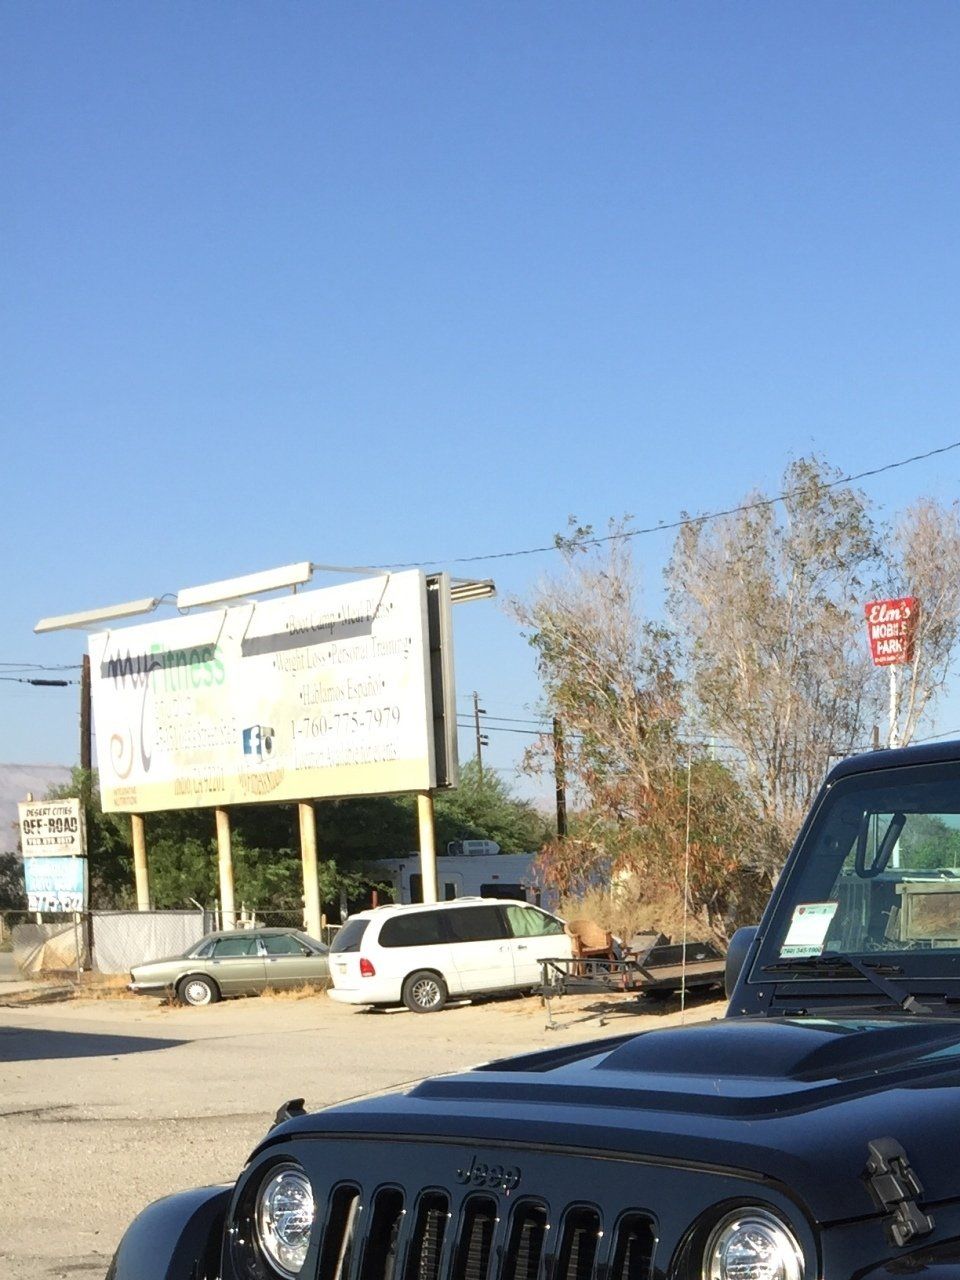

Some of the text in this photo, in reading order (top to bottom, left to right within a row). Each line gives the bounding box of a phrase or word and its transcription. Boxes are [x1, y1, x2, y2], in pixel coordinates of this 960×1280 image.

[869, 602, 911, 623] Elm's
[876, 638, 903, 655] PARK
[291, 705, 401, 740] 1-760-775-7979
[26, 806, 73, 817] DESERT CITIES
[23, 817, 78, 835] OFF-ROAD
[456, 1155, 521, 1196] Jeep
